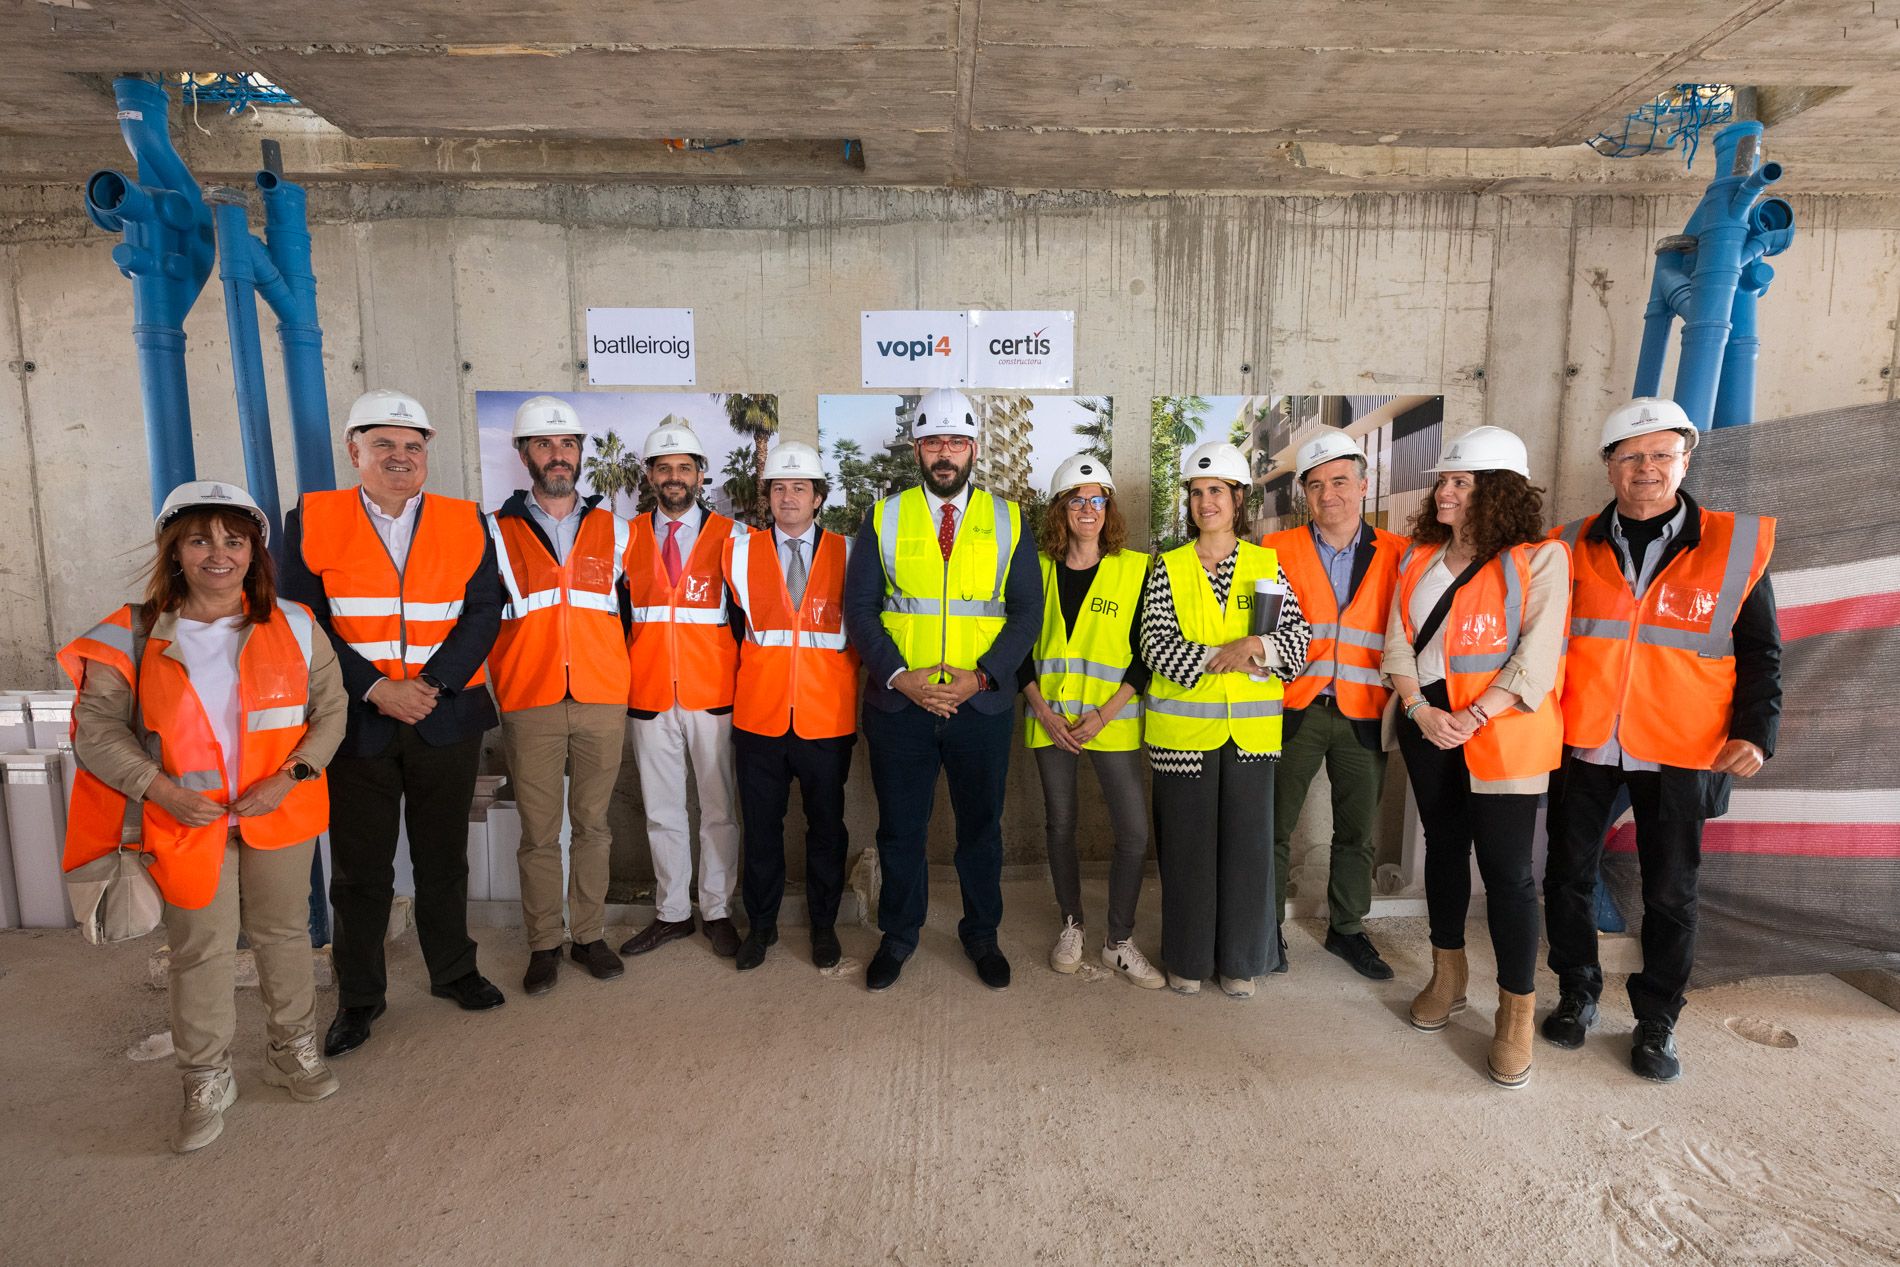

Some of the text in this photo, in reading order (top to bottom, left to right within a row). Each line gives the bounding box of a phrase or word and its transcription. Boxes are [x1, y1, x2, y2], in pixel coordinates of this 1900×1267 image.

[593, 335, 690, 359] batlleiroig
[876, 334, 952, 361] vopi4
[989, 334, 1051, 356] certis
[998, 358, 1042, 366] constructora
[1090, 597, 1119, 618] BIR
[1237, 595, 1254, 610] BI
